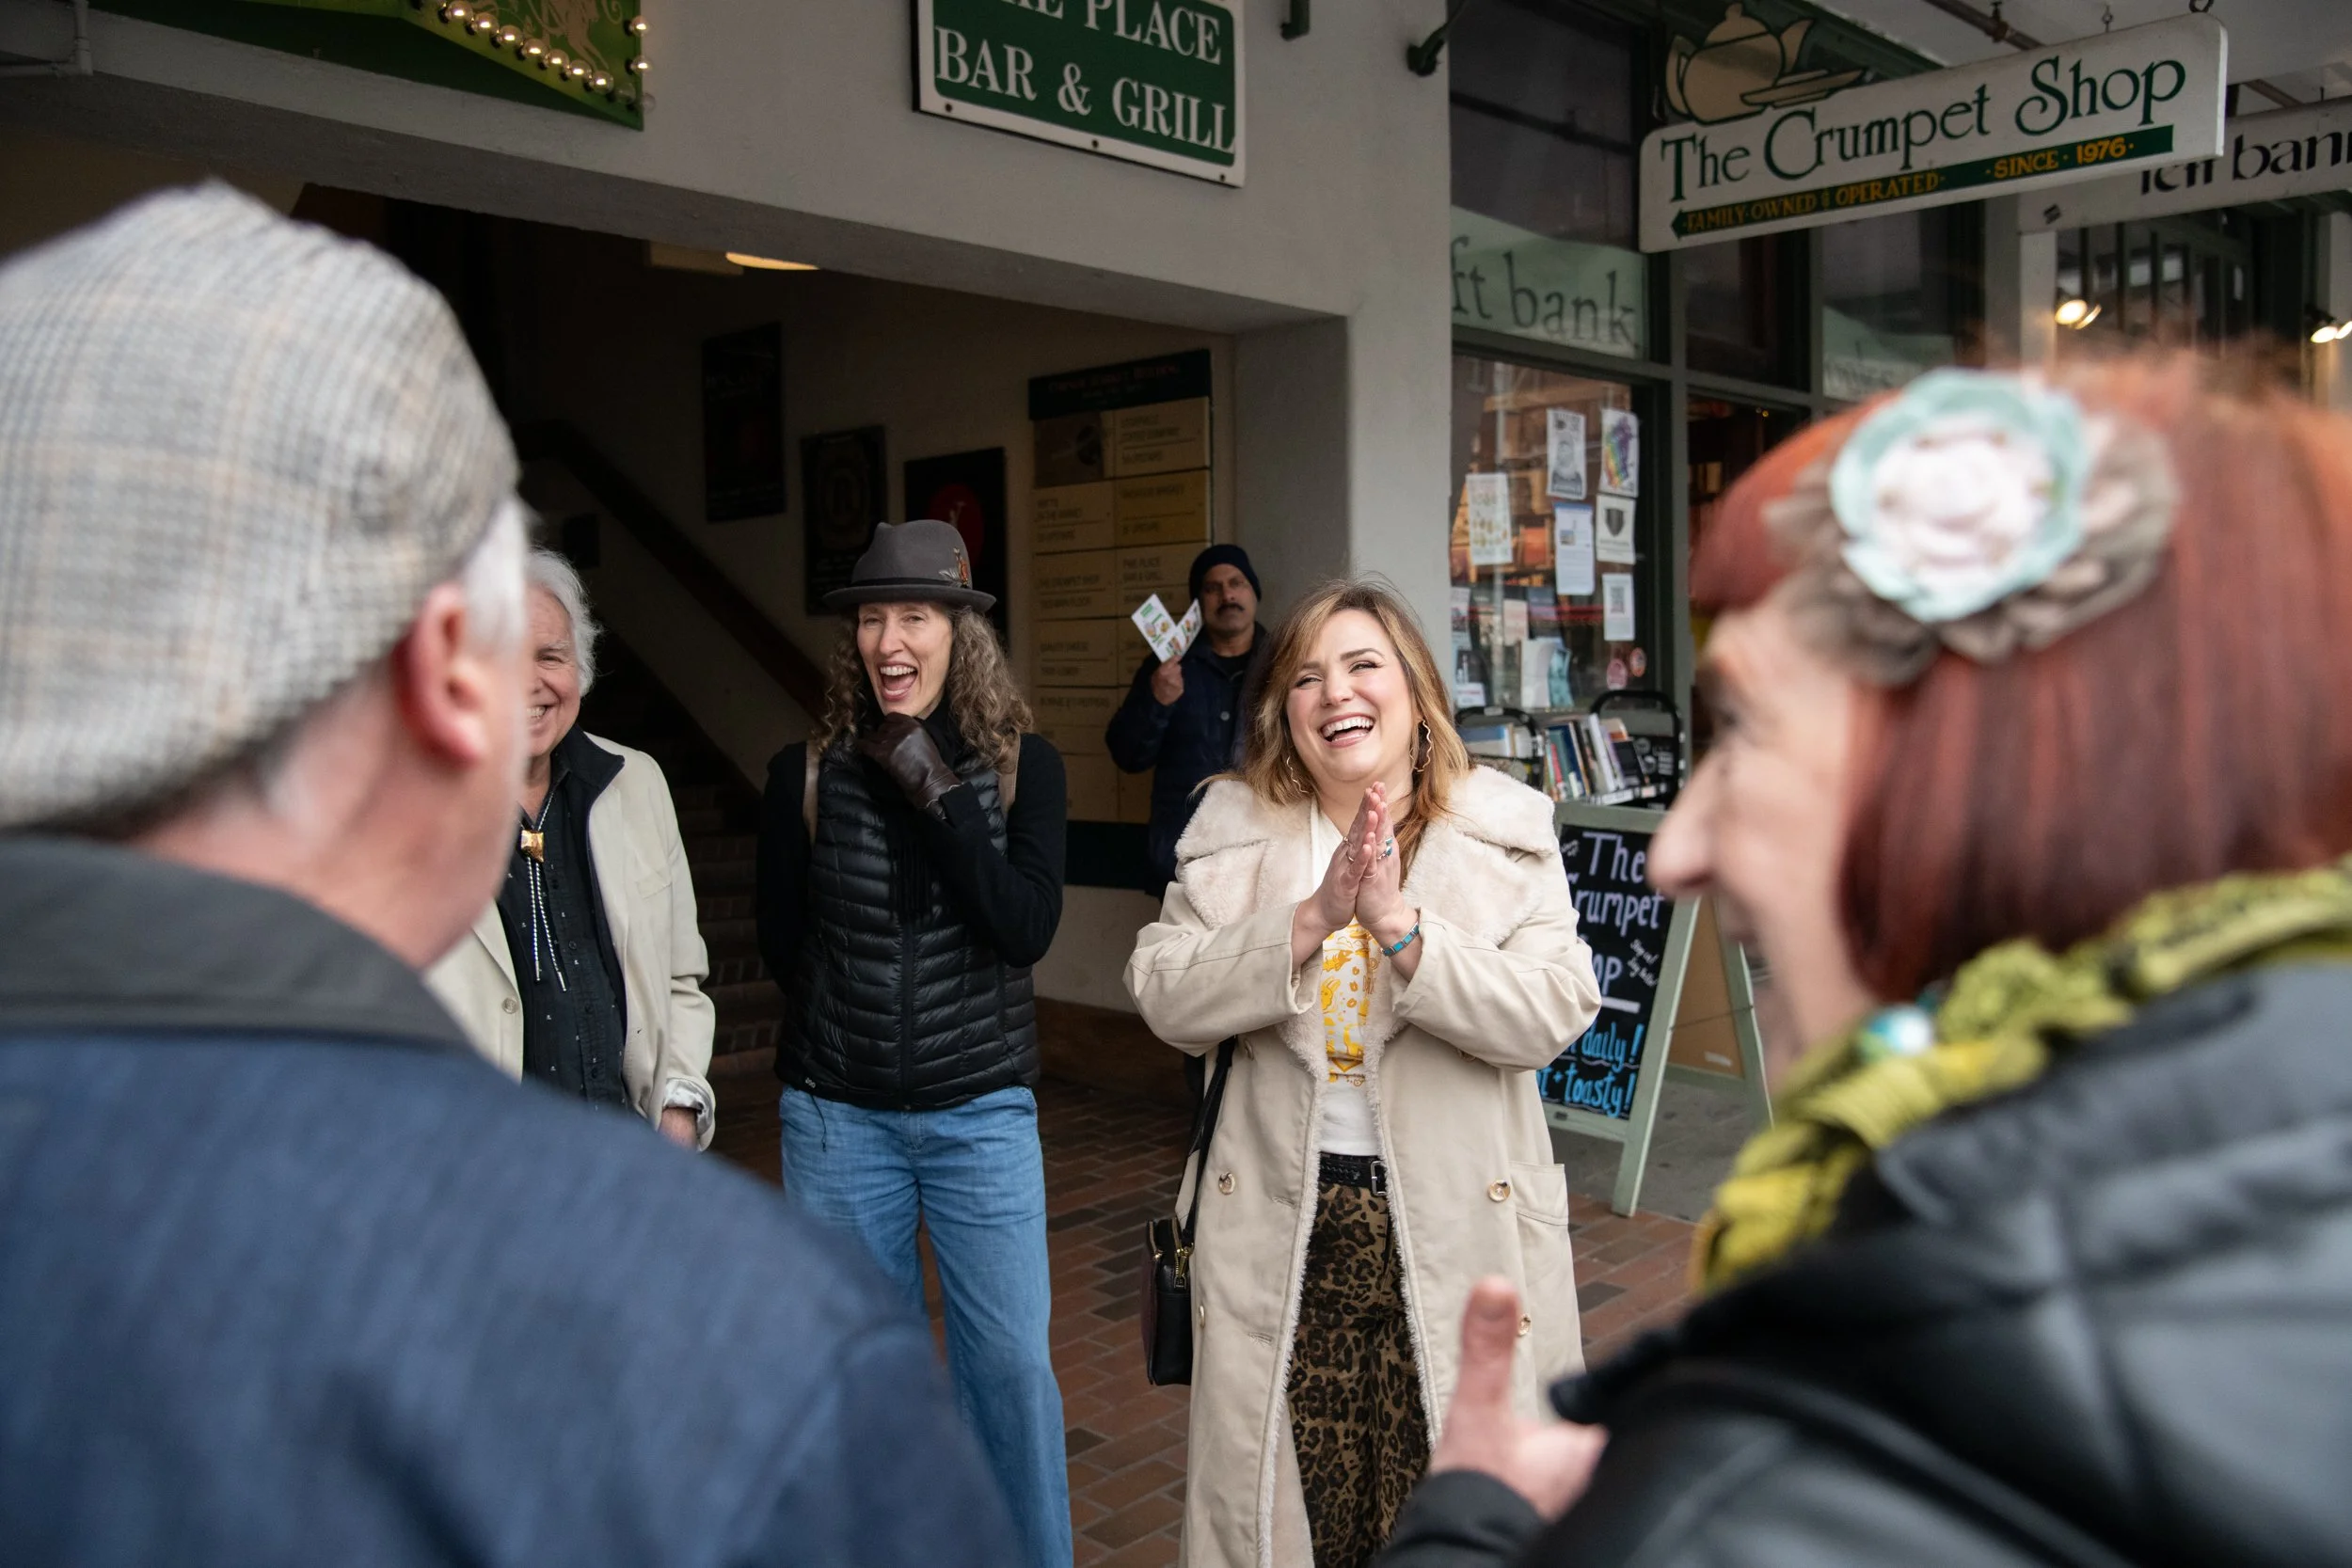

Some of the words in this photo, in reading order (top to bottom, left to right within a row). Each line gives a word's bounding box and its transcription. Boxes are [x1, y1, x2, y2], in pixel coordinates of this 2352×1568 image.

[1084, 0, 1221, 65] PLACE
[934, 25, 1037, 102] BAR
[1057, 62, 1091, 116] &
[1112, 76, 1236, 153] GRILL
[1661, 132, 1751, 203] The
[1764, 83, 1992, 181] Crumpet
[2014, 55, 2187, 136] Shop
[2233, 132, 2352, 181] ban
[1502, 248, 1640, 350] bank
[1582, 832, 1646, 884] The
[1574, 888, 1665, 938] rumpet
[1565, 1062, 1637, 1118] toasty!
